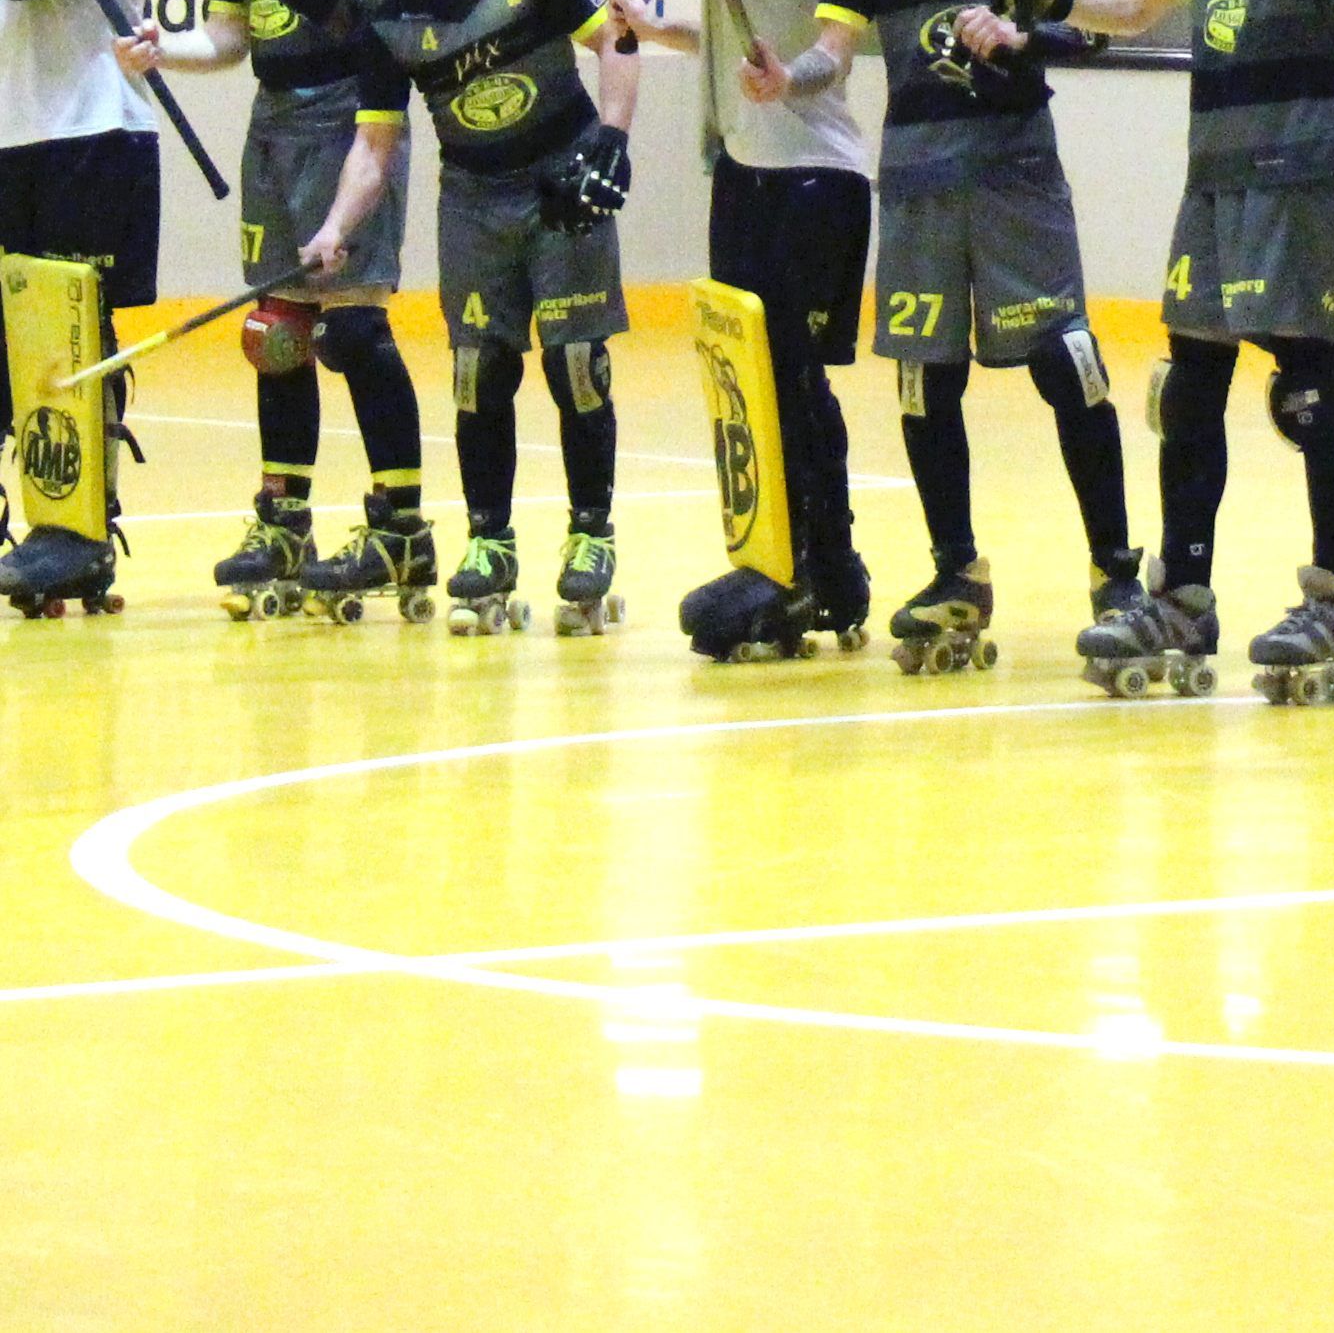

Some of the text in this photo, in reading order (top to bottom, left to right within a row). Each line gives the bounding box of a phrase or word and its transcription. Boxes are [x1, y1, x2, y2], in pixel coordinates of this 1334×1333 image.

[1167, 254, 1192, 301] 4
[461, 292, 490, 330] 4
[888, 291, 944, 337] 27
